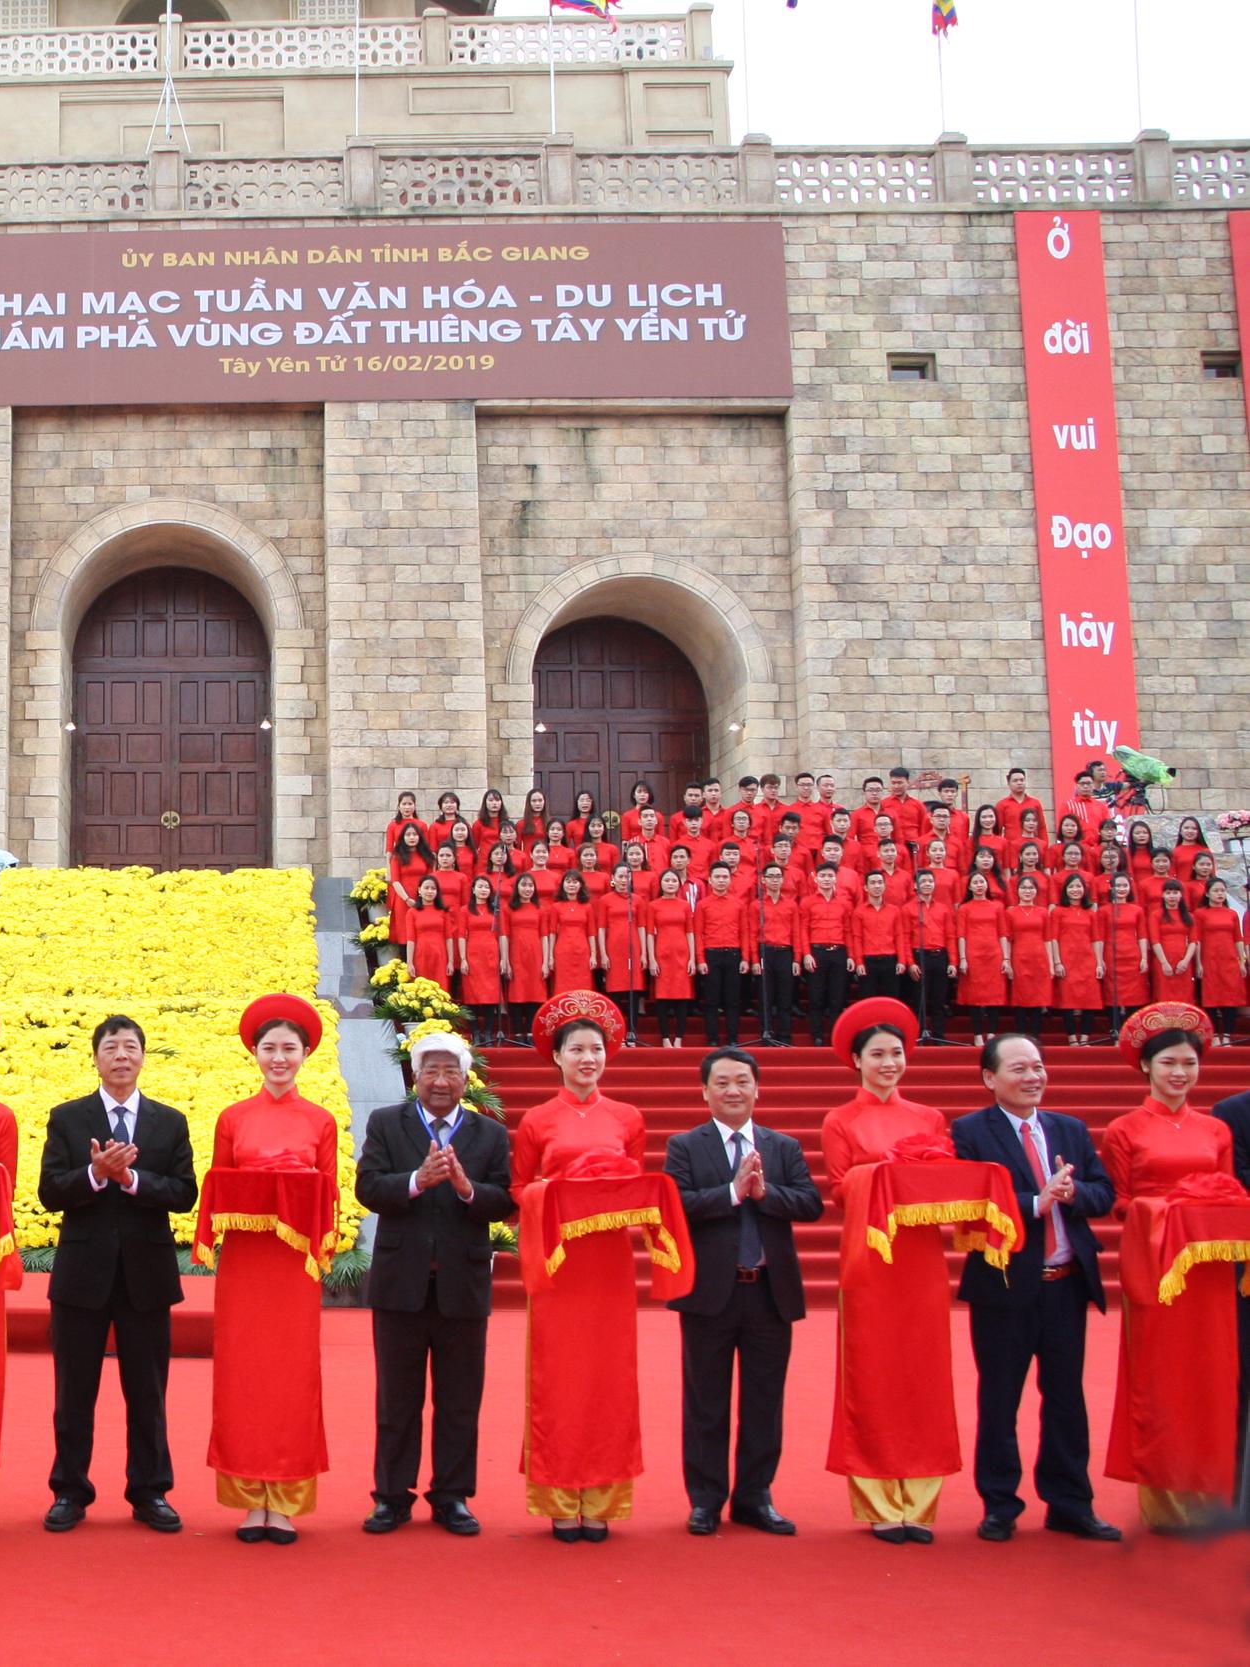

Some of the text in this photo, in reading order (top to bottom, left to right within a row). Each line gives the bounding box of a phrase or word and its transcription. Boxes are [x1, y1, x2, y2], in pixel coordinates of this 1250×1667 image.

[121, 241, 590, 268] ỦY BAN NHÂN DÂN TỈNH BẮC GIANG
[82, 290, 180, 320] MẠC
[194, 277, 303, 313] TUẦN
[318, 281, 406, 311] VĂN
[422, 278, 518, 309] HÓA
[556, 284, 612, 308] DU
[628, 283, 723, 313] LỊCH
[76, 318, 157, 348] PHÁ
[167, 317, 283, 347] VÙNG
[293, 310, 372, 345] ĐẤT
[380, 313, 522, 343] THIÊNG
[531, 313, 605, 342] TÂY
[614, 312, 688, 341] YÊN
[698, 310, 747, 341] TỬ
[219, 354, 495, 377] Tây Yên Tử 16/02/2019
[1043, 216, 1117, 754] Ở đời vui Đạo hãy tùy
